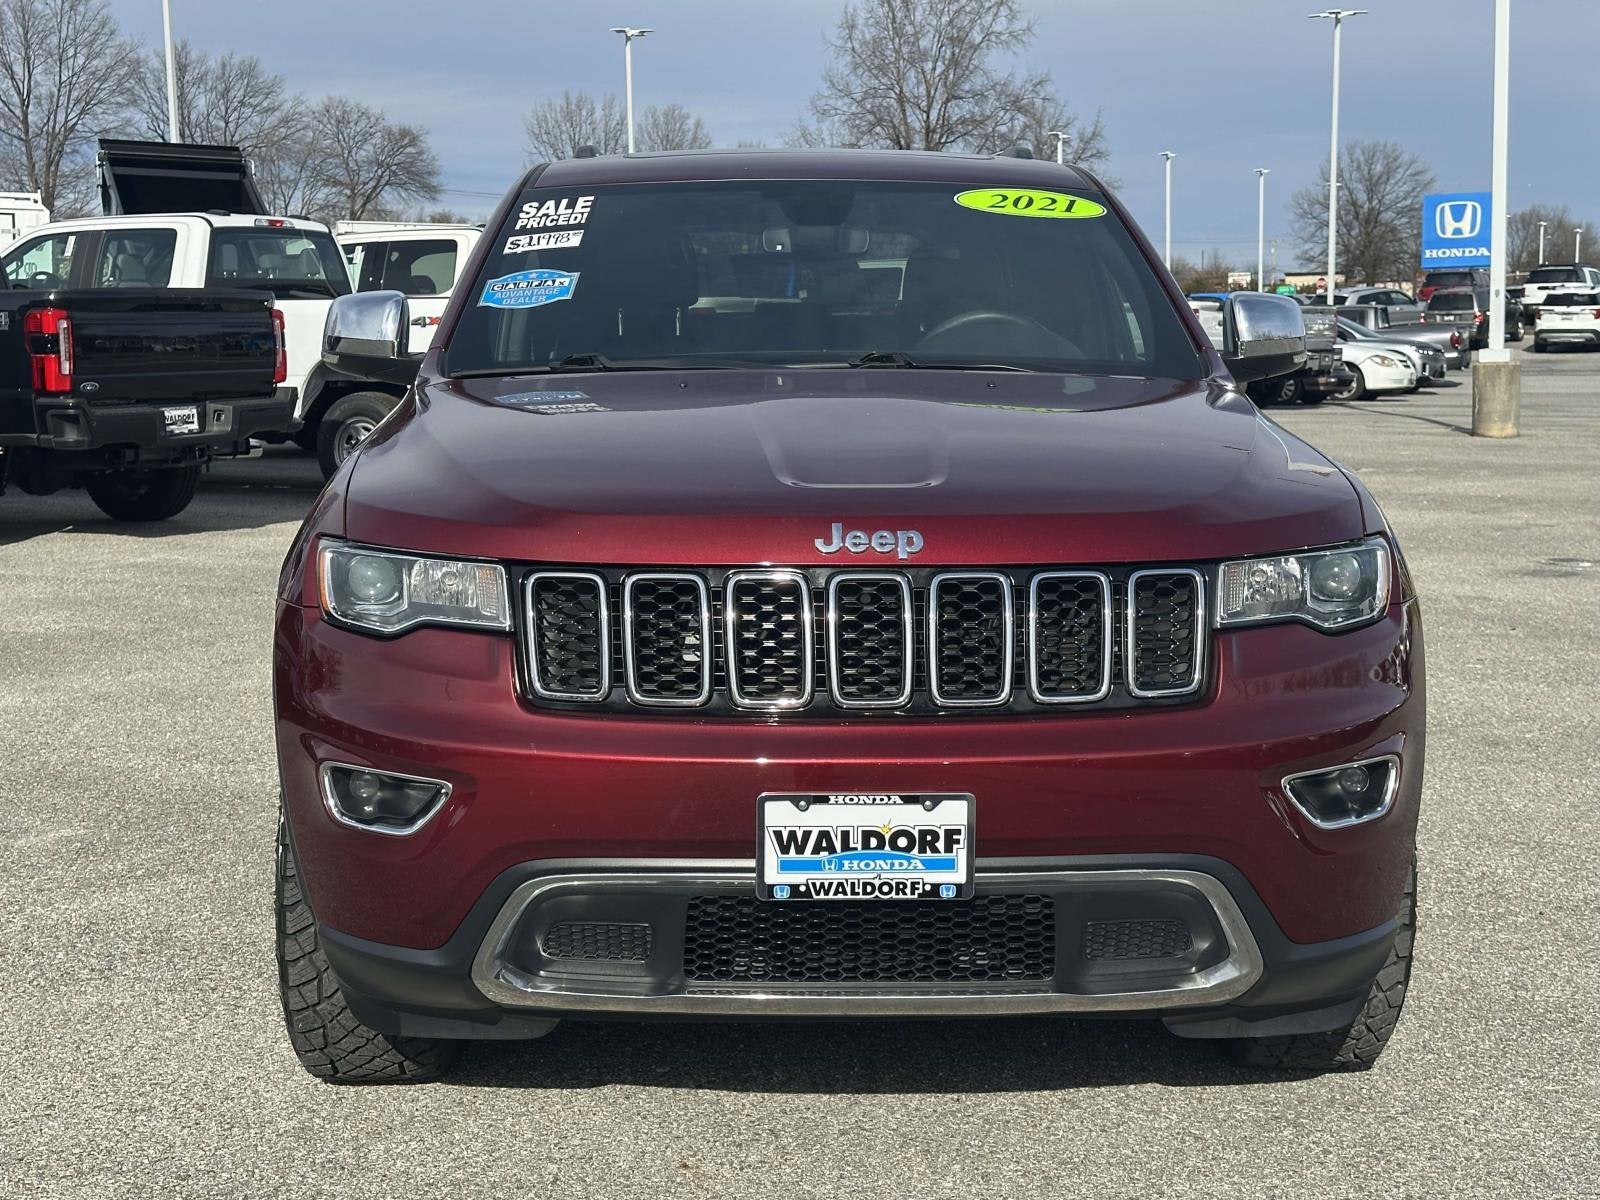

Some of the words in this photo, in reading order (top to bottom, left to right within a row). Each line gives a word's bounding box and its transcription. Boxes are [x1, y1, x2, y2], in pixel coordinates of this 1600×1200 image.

[519, 195, 595, 219] SALE
[987, 194, 1077, 213] 2021
[515, 212, 589, 230] PRICED!
[1424, 247, 1491, 258] HONDA
[491, 277, 569, 291] CARFAX
[493, 287, 560, 299] ADVANTAGE
[502, 295, 546, 305] DEALER
[814, 522, 924, 560] Jeep
[828, 795, 904, 805] HONDA
[771, 826, 964, 856] WALDORF
[842, 859, 926, 871] HONDA
[809, 880, 923, 898] WALDORF
